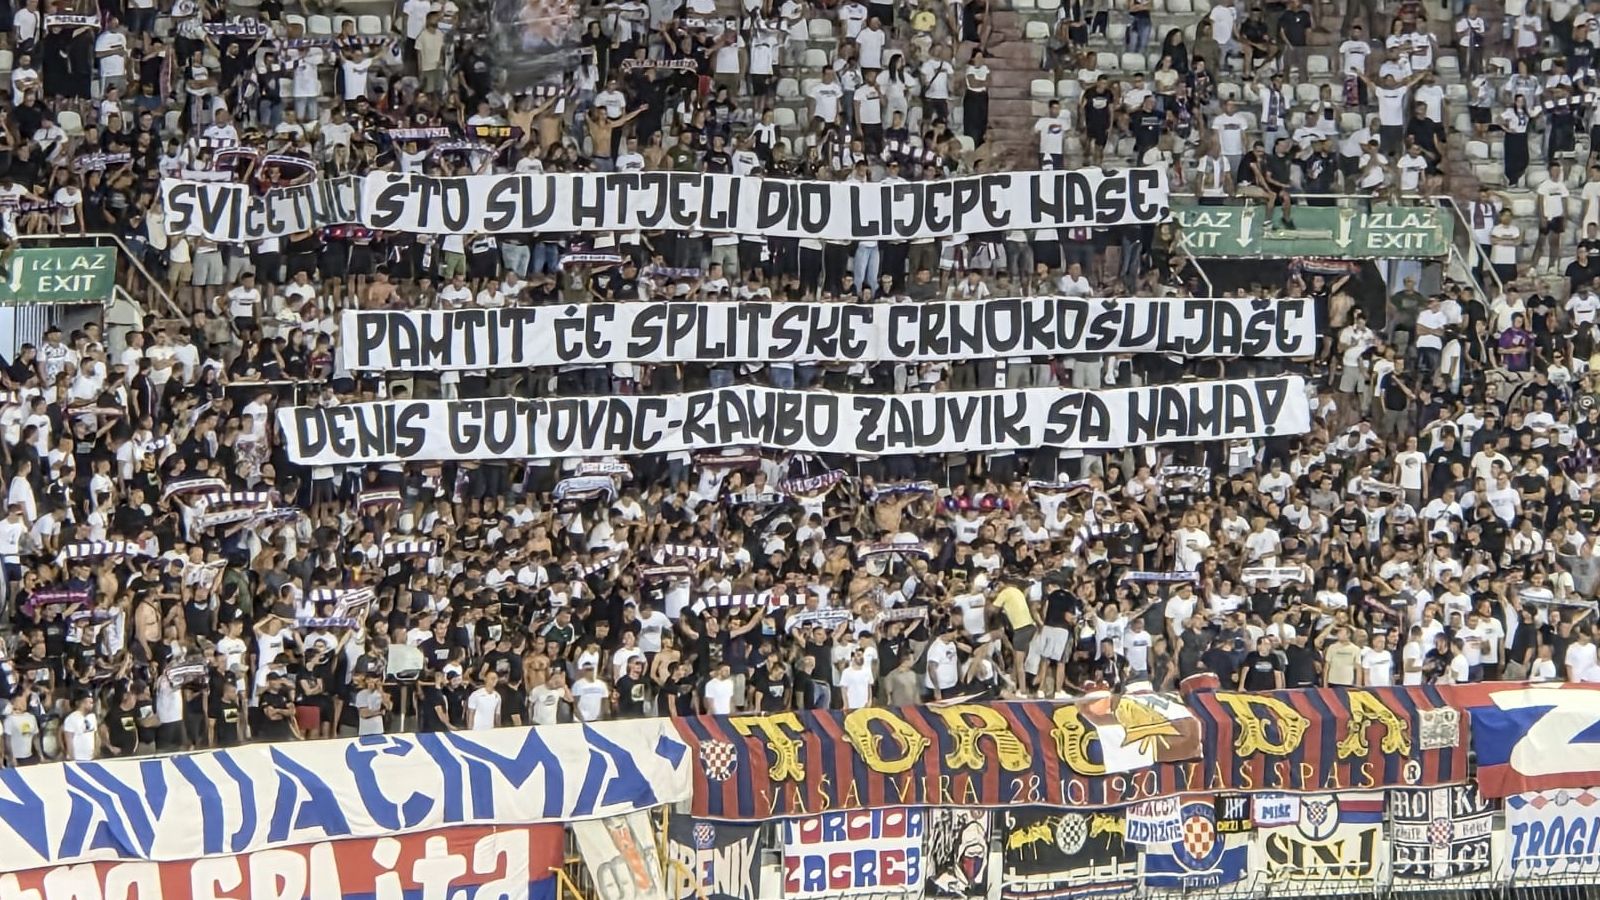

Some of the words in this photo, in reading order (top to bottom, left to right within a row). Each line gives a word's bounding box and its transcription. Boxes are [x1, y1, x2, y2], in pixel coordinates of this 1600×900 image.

[168, 183, 243, 240] SVI
[371, 172, 470, 228] ŠTO
[484, 175, 556, 232] SU
[572, 173, 741, 229] HTJELI
[757, 181, 831, 234] DIO
[850, 174, 1012, 237] LIJEPE
[1030, 168, 1170, 224] NAŠE,
[1179, 210, 1231, 228] LAZ
[1361, 212, 1438, 229] IZLAZ
[1176, 231, 1221, 248] XIT
[1367, 232, 1428, 248] EXIT
[38, 274, 96, 292] EXIT
[357, 307, 536, 367] PAMTIT
[627, 302, 874, 359] SPLITSKE
[889, 298, 1305, 356] CRNOKOŠULJAŠE
[299, 401, 430, 458] DENIS
[854, 391, 1031, 451] ZAUVIK
[1043, 391, 1111, 445] SA
[1128, 378, 1289, 443] NAMA!
[889, 773, 980, 805] VIRA
[1010, 774, 1046, 805] 28.
[1266, 828, 1376, 876] SINJ
[1512, 816, 1600, 870] TROGI
[785, 846, 920, 893] ZAGREB
